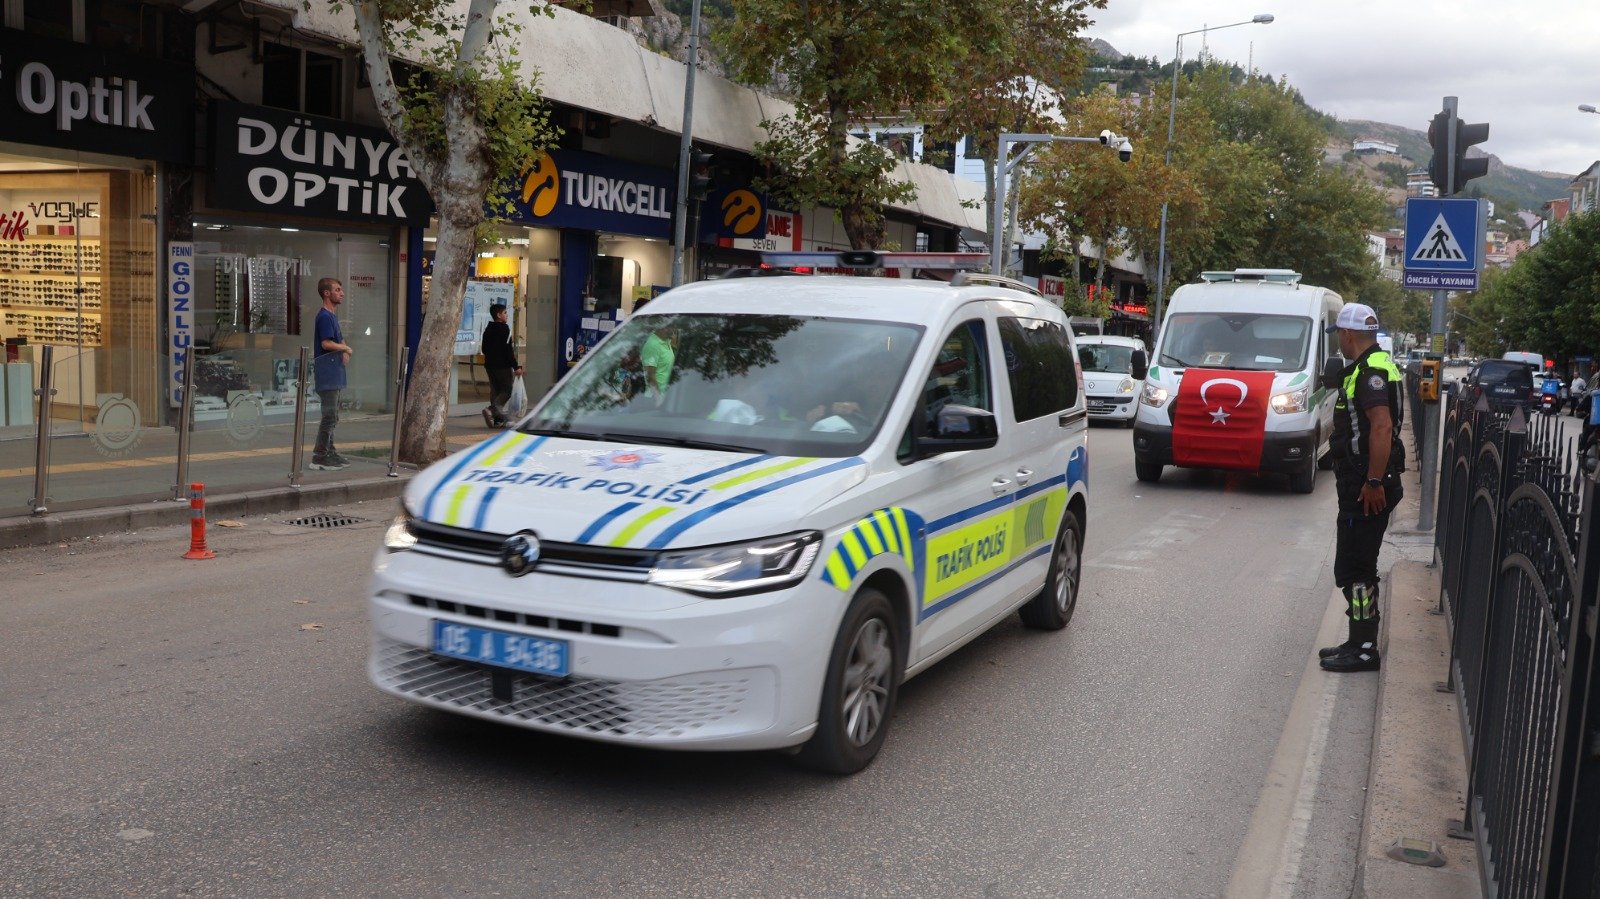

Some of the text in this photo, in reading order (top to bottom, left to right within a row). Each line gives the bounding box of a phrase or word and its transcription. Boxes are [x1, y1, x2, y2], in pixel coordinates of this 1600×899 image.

[16, 62, 155, 131] Optik
[238, 117, 417, 180] DÜNYA
[562, 170, 671, 219] TURKCELL
[752, 238, 777, 250] SEVEN
[767, 214, 792, 237] ANE
[1406, 275, 1439, 285] ÖNCELİK
[463, 469, 709, 504] TRAFİK POLİSİ
[936, 522, 1008, 583] TRAFİK POLİSİ
